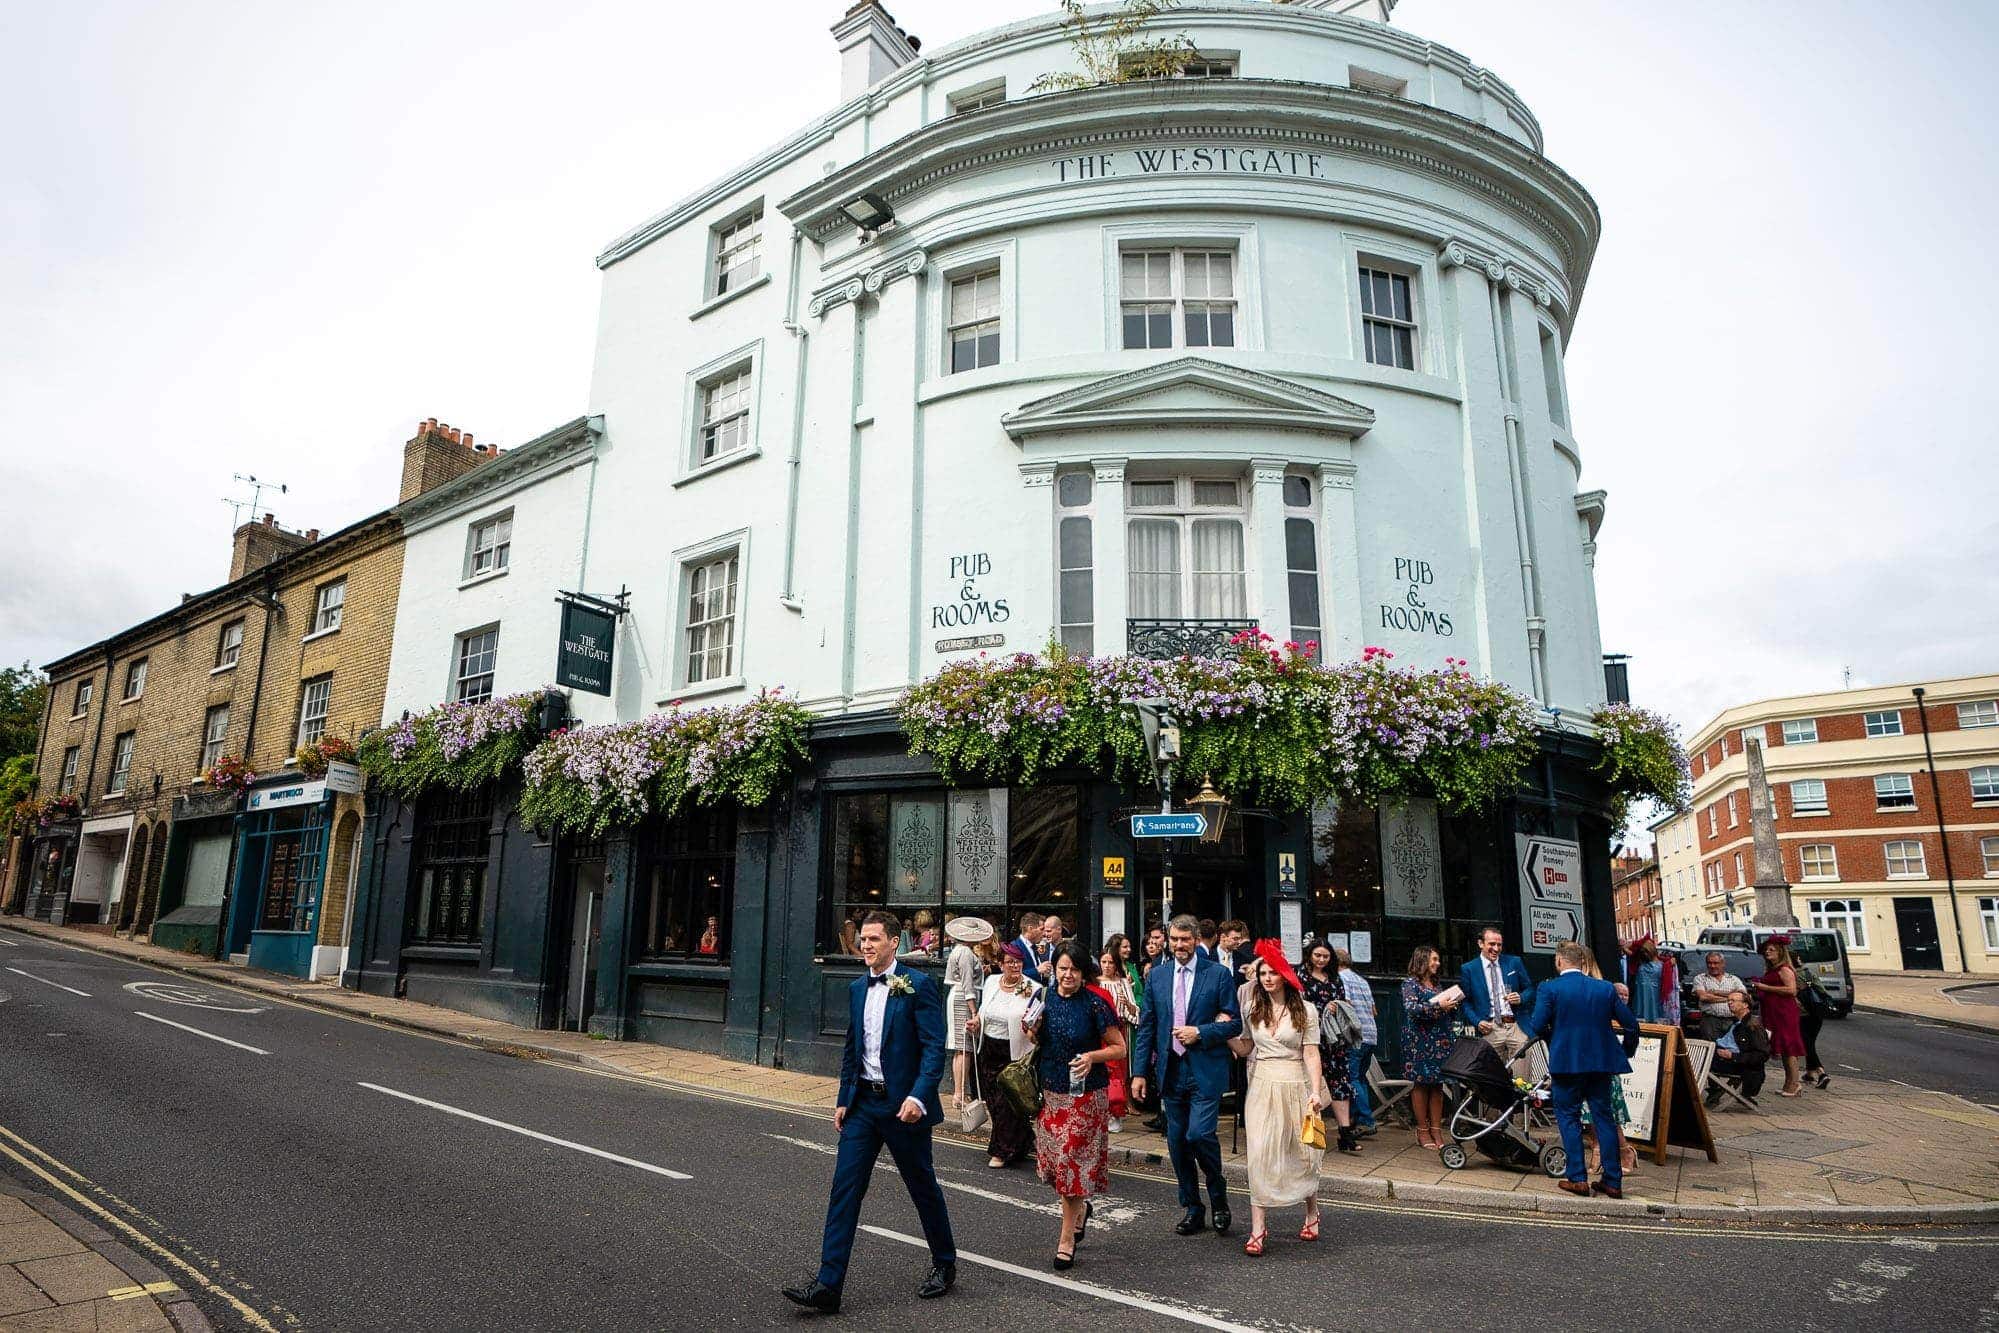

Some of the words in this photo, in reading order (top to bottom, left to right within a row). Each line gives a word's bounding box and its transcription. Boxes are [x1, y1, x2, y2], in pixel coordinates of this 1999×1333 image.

[1052, 152, 1116, 182] THE
[1134, 147, 1324, 178] WESTGATE
[950, 552, 991, 579] PUB
[1394, 557, 1434, 585] PUB
[960, 578, 981, 601] &
[1406, 584, 1426, 608] &
[932, 598, 1010, 628] ROOMS
[1380, 605, 1453, 637] ROOMS
[580, 634, 596, 648] THE
[564, 639, 609, 663] WESTGATE
[1148, 821, 1196, 831] Samaritans
[959, 845, 994, 853] HOTEL
[1541, 845, 1577, 858] Southampton
[1107, 863, 1121, 873] AA
[1542, 855, 1564, 867] Romsey
[1545, 888, 1573, 901] University
[1533, 910, 1541, 919] All
[1543, 911, 1557, 920] other
[1536, 921, 1555, 929] routes
